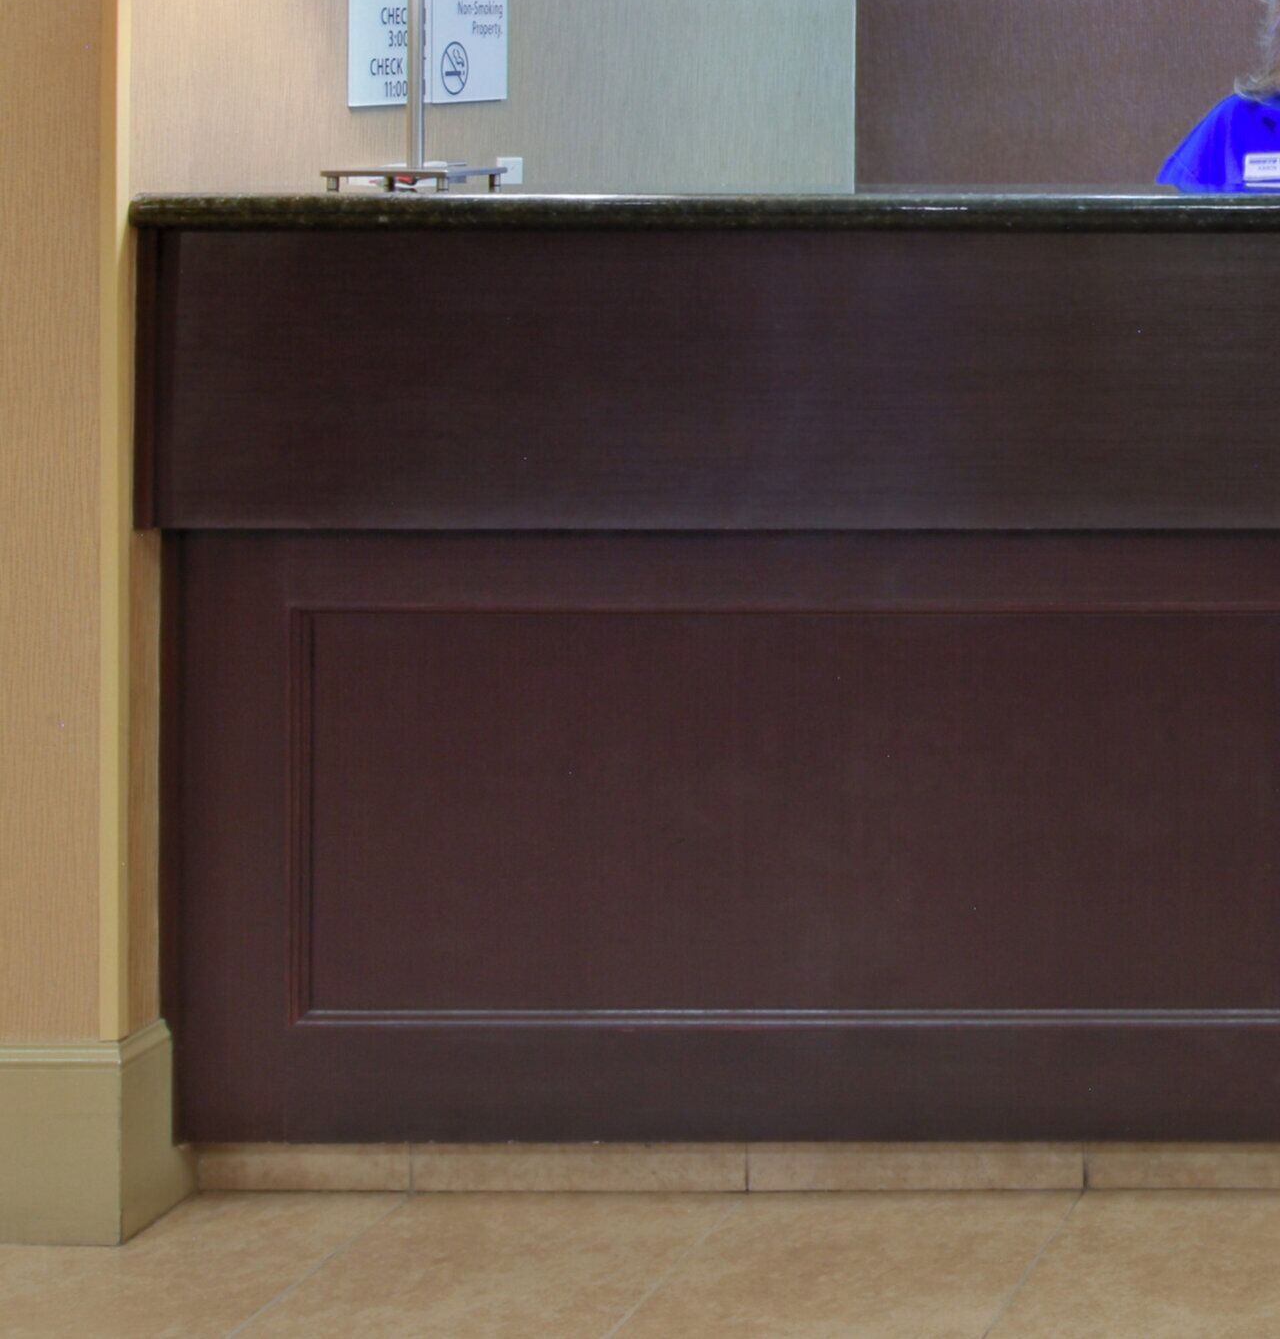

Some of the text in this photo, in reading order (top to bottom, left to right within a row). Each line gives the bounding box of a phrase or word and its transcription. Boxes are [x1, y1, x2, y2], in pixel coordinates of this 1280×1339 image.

[381, 7, 407, 25] CHEC
[458, 1, 503, 19] Non-Smoking
[370, 58, 403, 75] CHECK
[384, 81, 408, 97] 11:00
